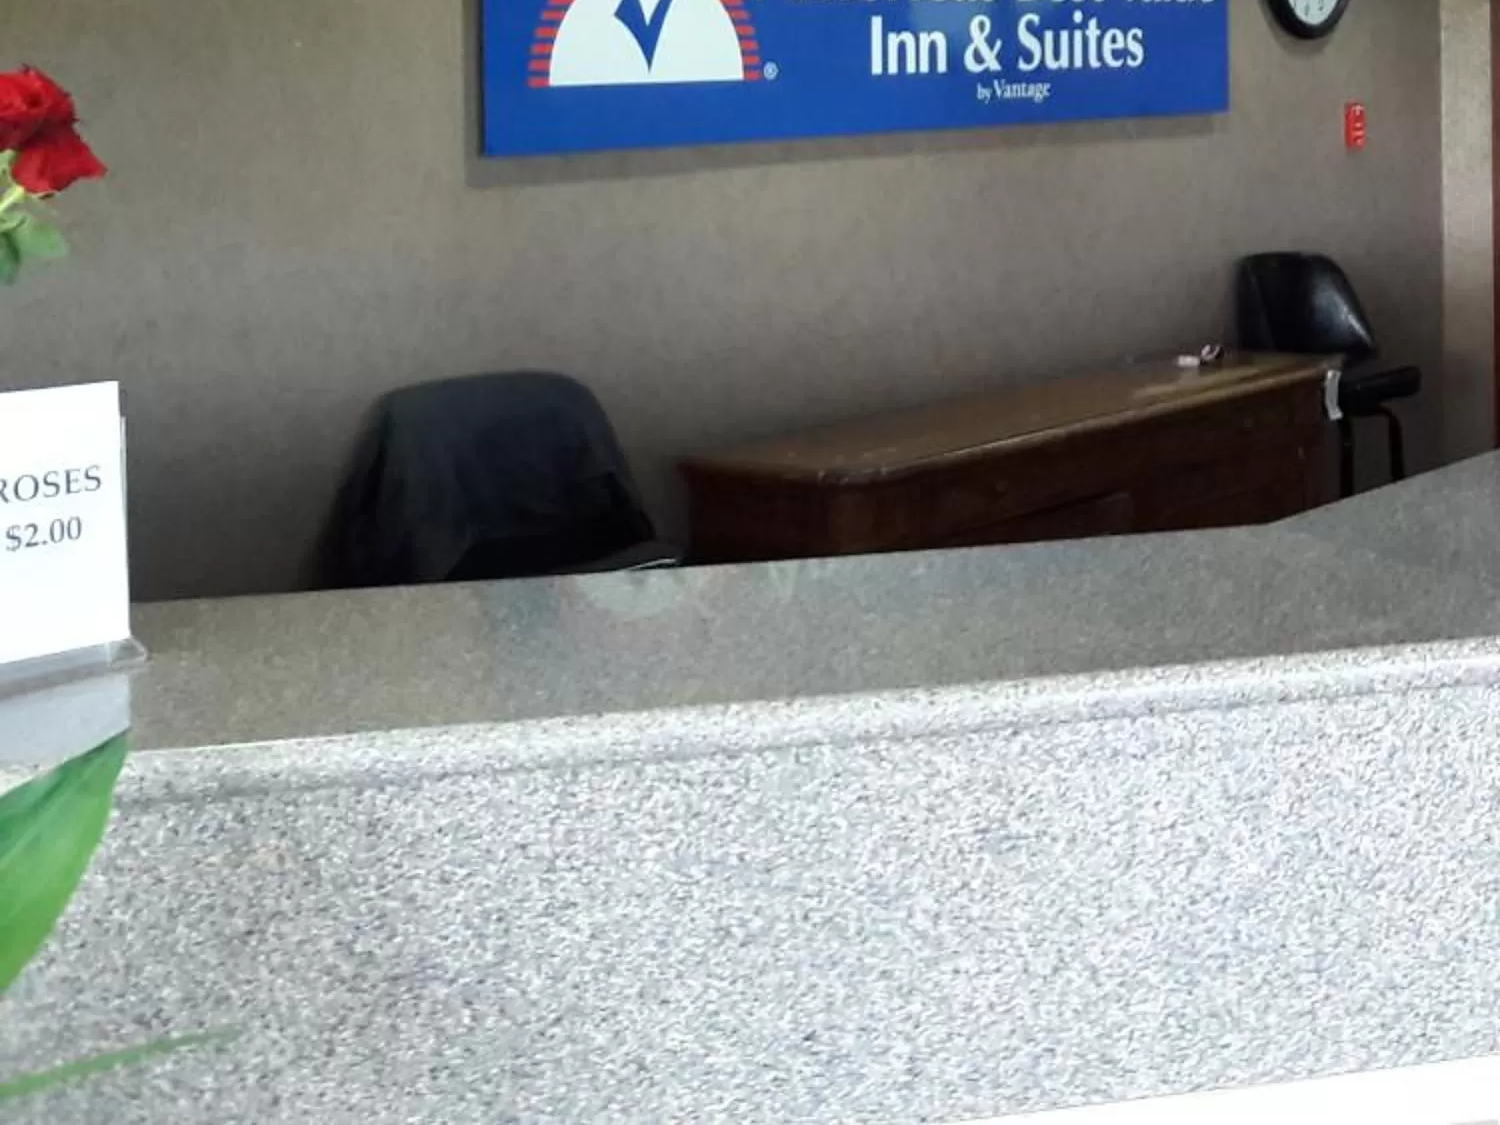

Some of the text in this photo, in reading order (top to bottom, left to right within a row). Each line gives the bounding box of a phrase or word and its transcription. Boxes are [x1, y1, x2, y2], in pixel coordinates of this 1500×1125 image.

[870, 9, 1144, 76] Inn & Suites
[977, 79, 1052, 103] by Vantage
[5, 515, 82, 552] $2.00
